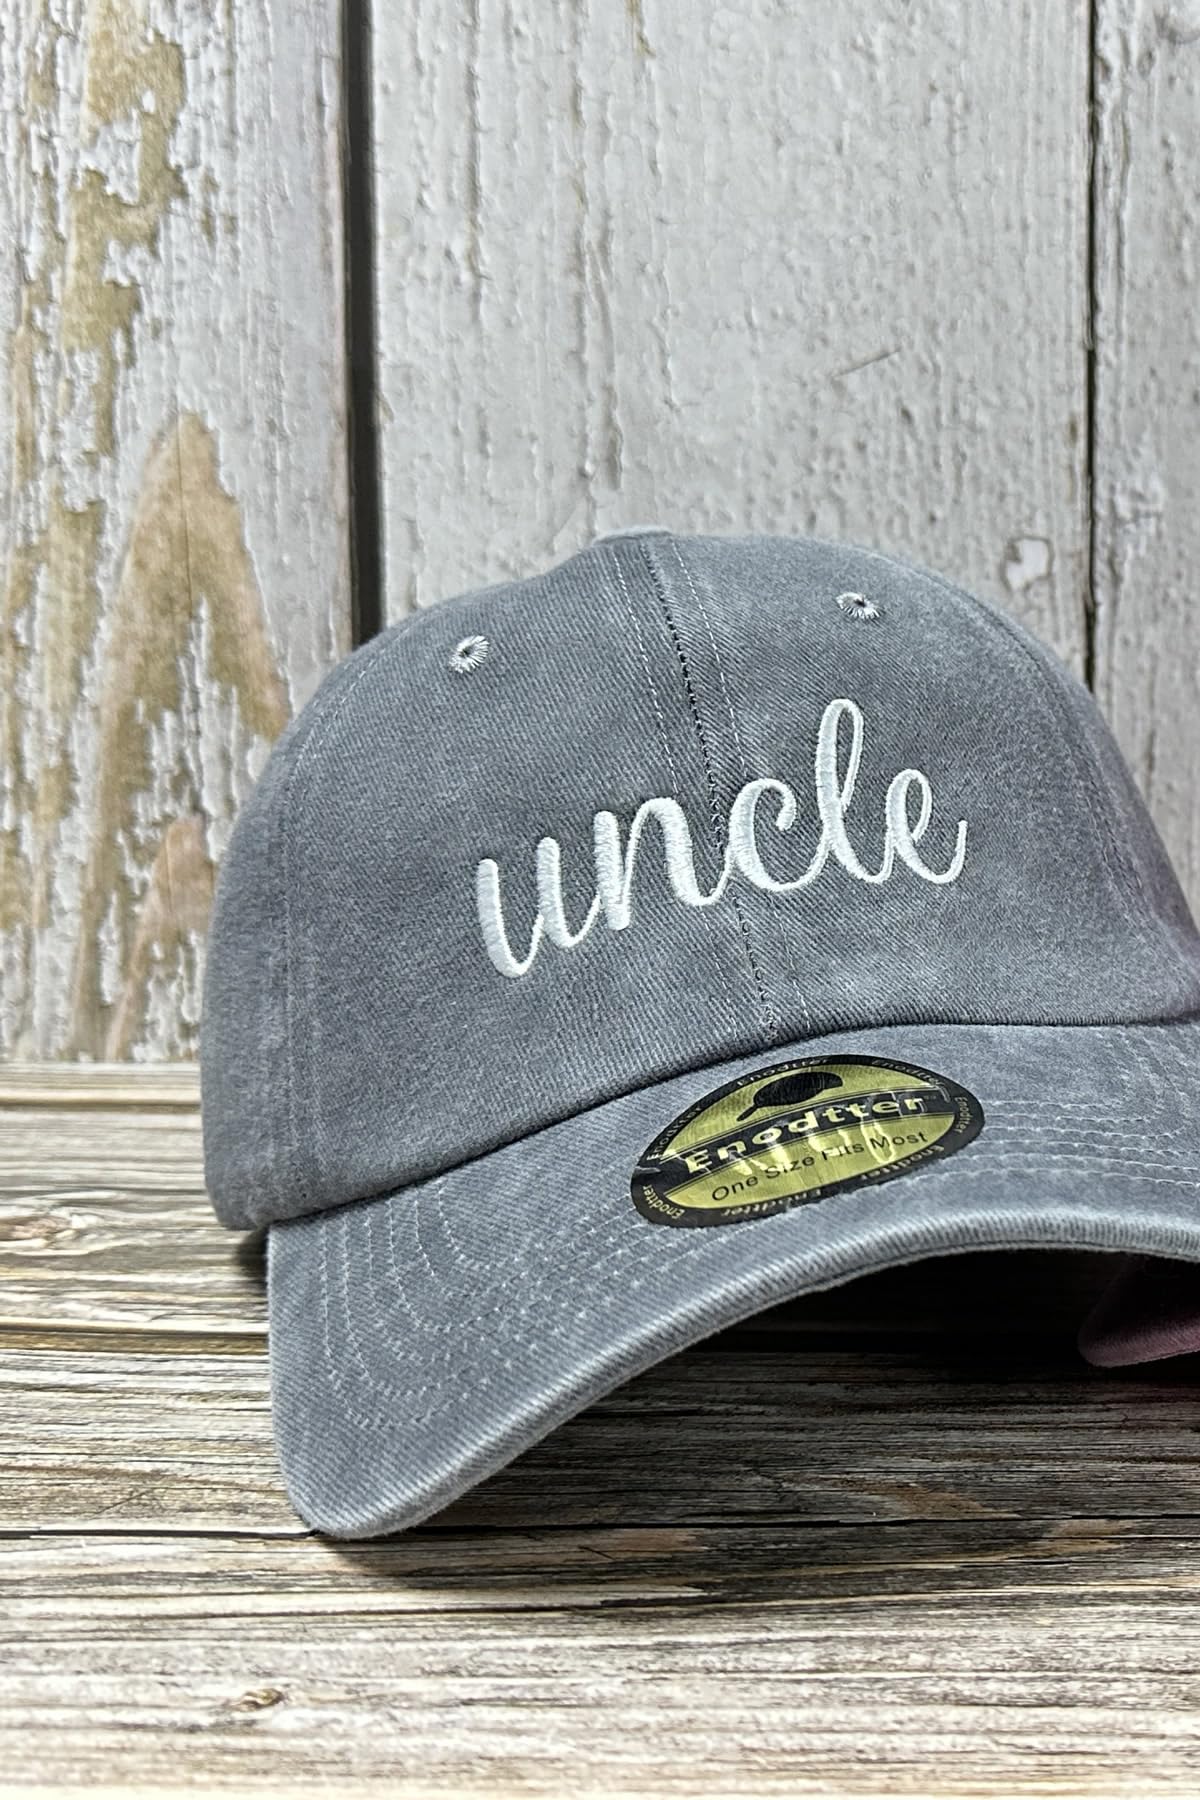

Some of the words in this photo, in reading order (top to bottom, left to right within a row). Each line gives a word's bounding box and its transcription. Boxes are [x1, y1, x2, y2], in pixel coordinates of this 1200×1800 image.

[477, 698, 967, 977] uncle
[685, 1097, 924, 1173] Enodtter
[711, 1175, 759, 1202] One
[764, 1155, 815, 1179] Size
[869, 1131, 929, 1150] Most
[642, 1184, 686, 1220] Enodtter
